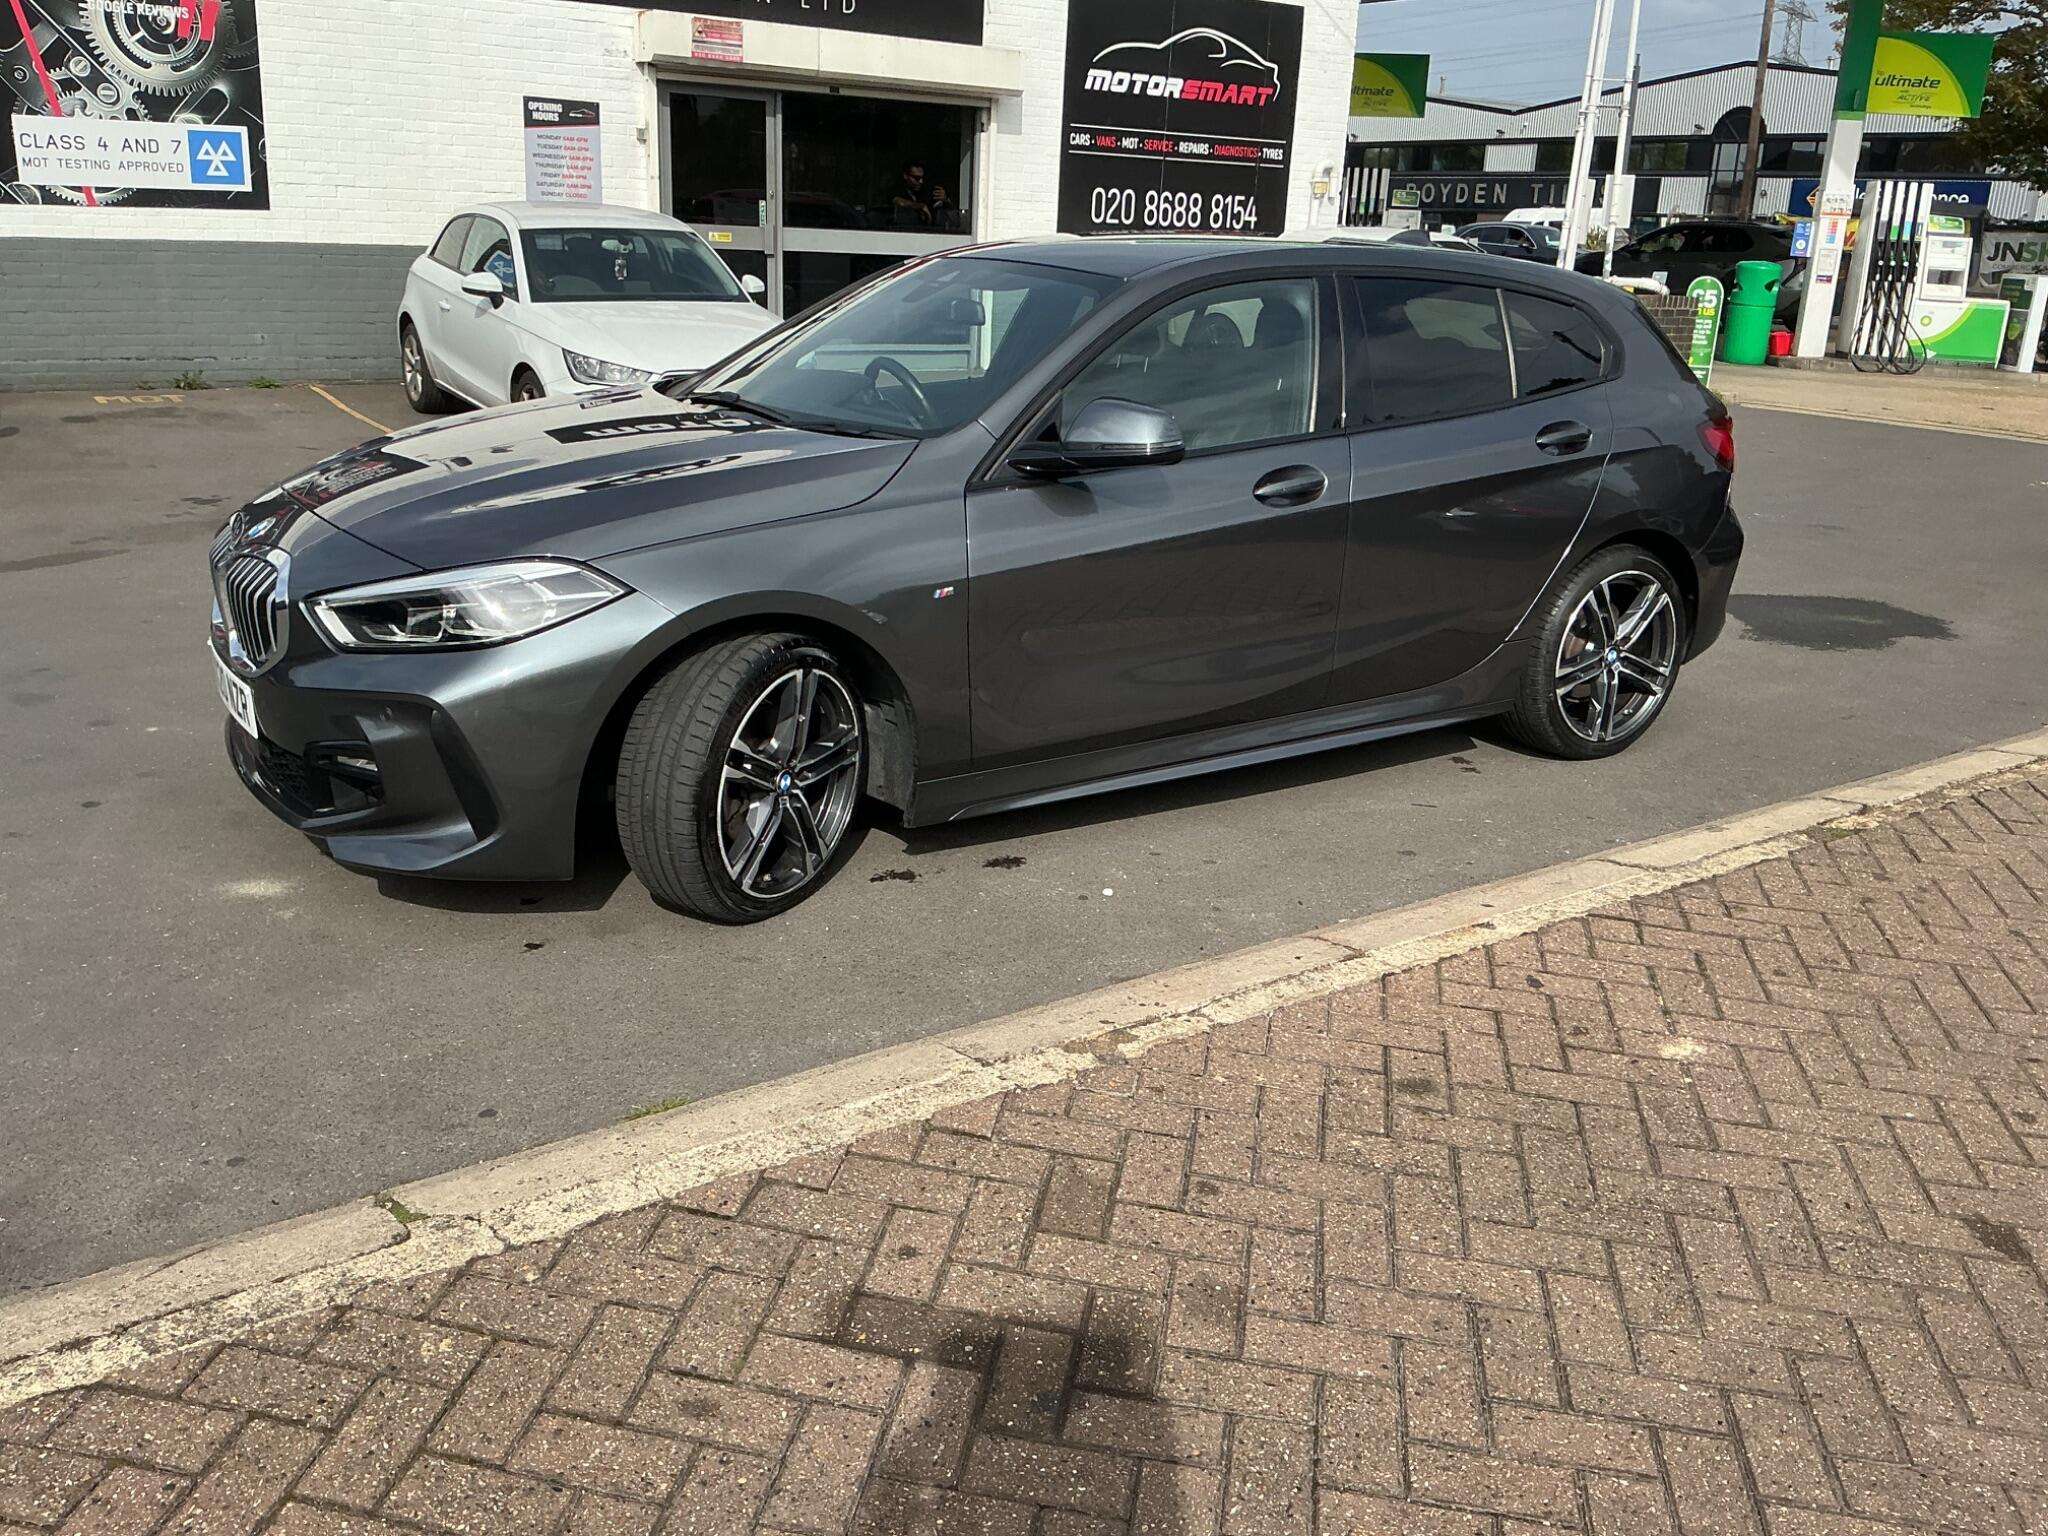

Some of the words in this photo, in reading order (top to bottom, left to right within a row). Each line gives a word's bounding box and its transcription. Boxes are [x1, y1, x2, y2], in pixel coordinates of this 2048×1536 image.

[137, 3, 190, 19] REVIEWS
[1084, 68, 1274, 107] MOTORSMART
[1874, 74, 1941, 89] ultimate
[528, 101, 562, 113] OPENING
[532, 111, 559, 122] HOURS
[19, 132, 86, 151] CLASS
[97, 137, 109, 151] 4
[121, 138, 160, 154] AND
[170, 140, 182, 155] 7
[537, 133, 561, 141] MONDAY
[1069, 133, 1091, 146] CARS
[1096, 135, 1117, 148] VANS
[1121, 137, 1139, 149] MOT
[1143, 139, 1173, 152] SERVICE
[1178, 142, 1210, 155] REPAIRS
[1213, 143, 1258, 157] DIAGNOSTICS
[1262, 148, 1284, 161] TYRES
[22, 157, 49, 168] MOT
[57, 157, 111, 171] TESTING
[118, 160, 184, 173] APPROVED
[1090, 187, 1136, 225] 020
[1143, 190, 1202, 228] 8688
[1209, 193, 1258, 230] 8154
[93, 394, 186, 404] MOT
